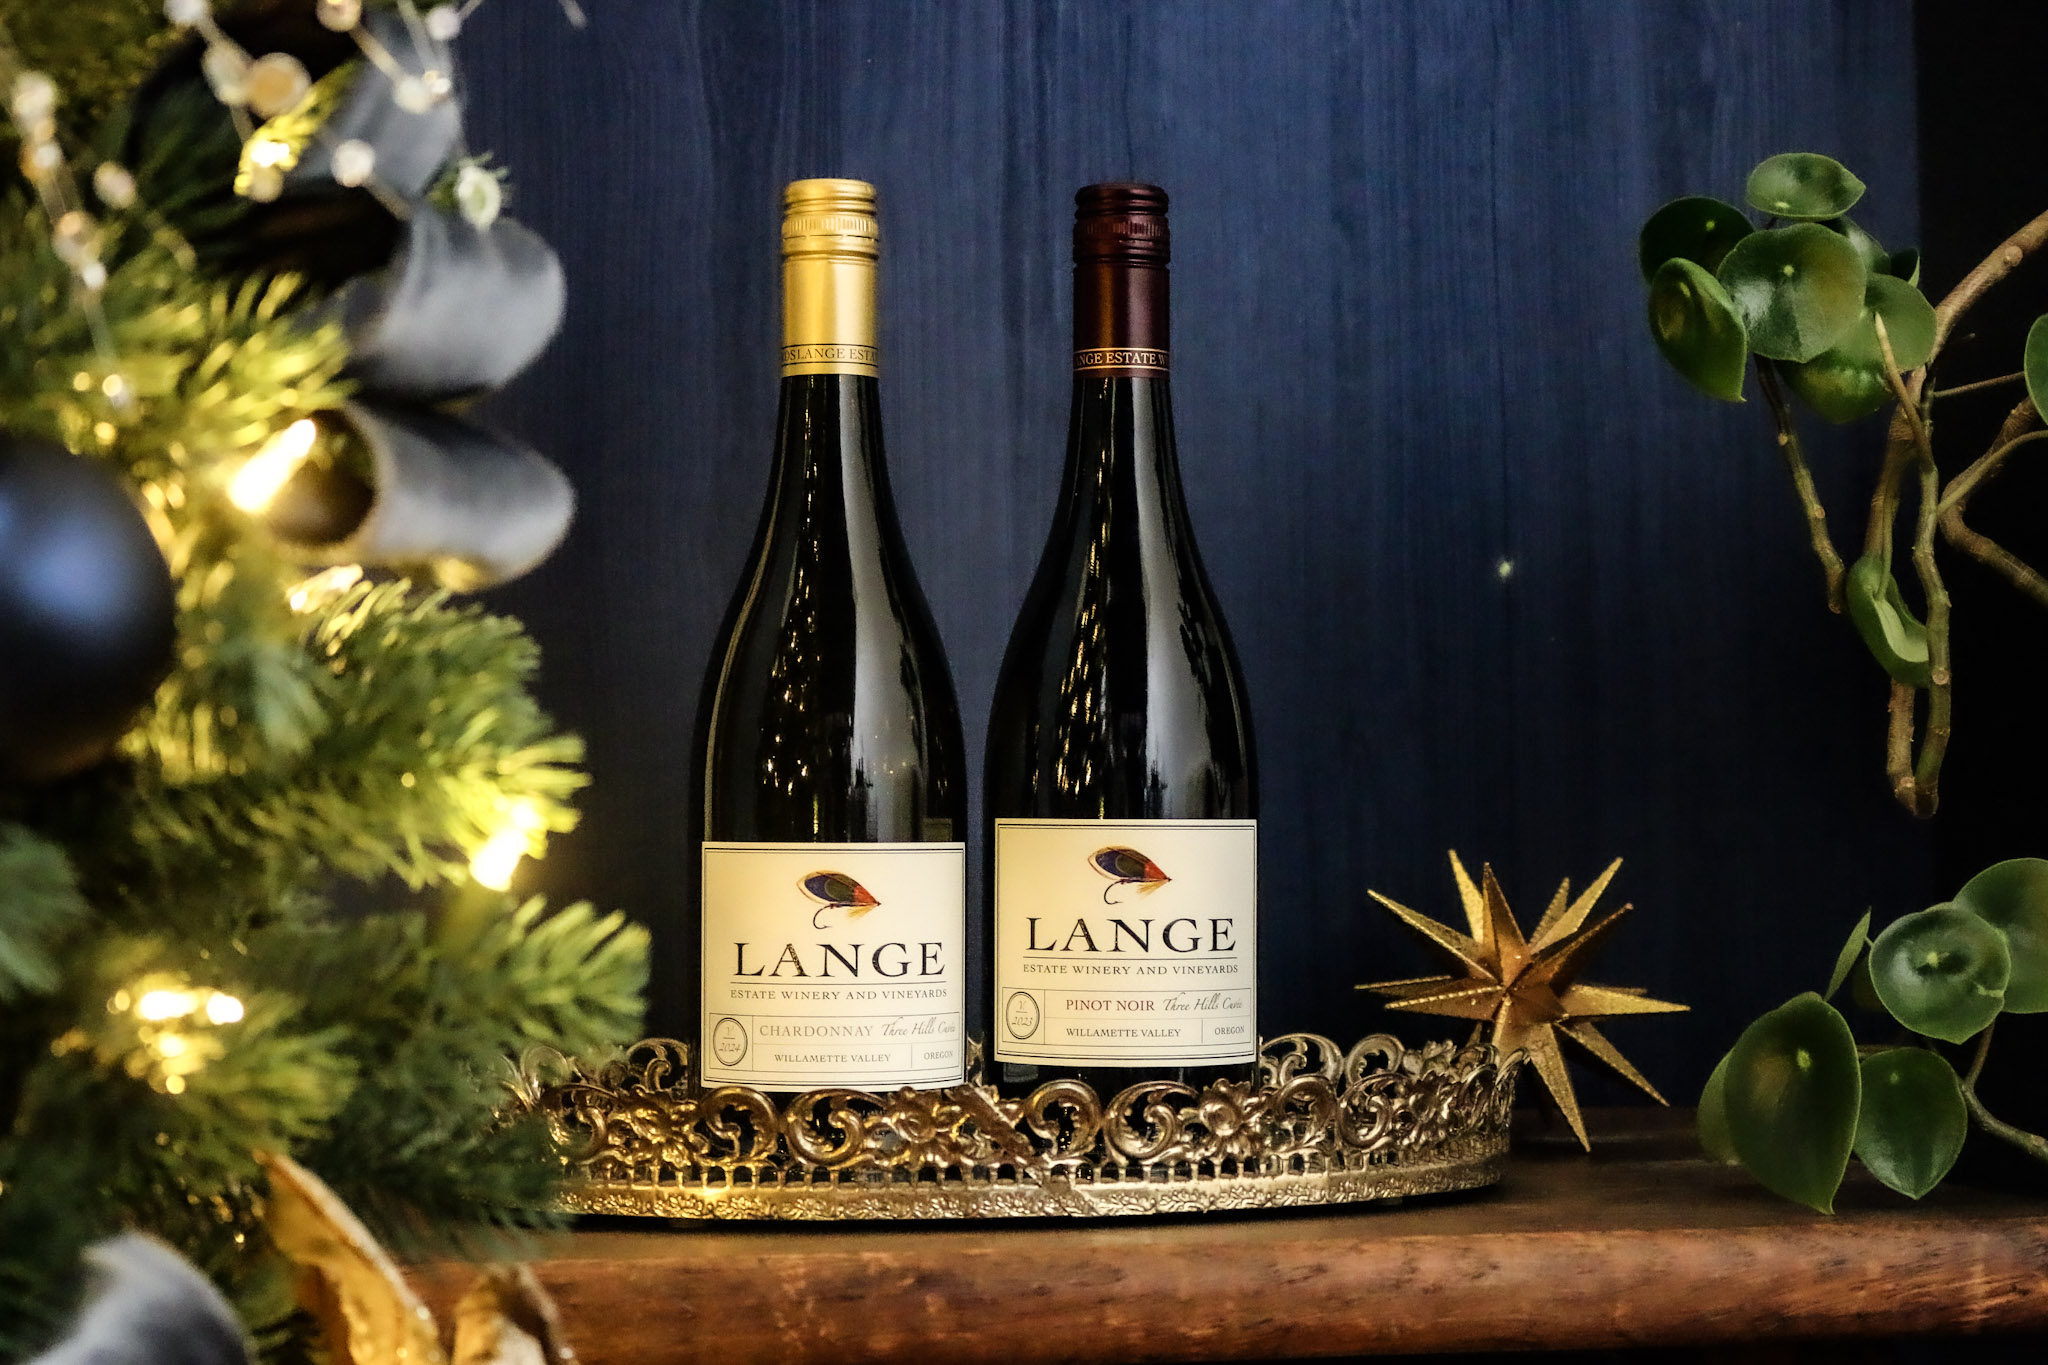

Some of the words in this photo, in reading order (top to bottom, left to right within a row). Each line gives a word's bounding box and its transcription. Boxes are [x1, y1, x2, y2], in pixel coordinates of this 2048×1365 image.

[1106, 352, 1157, 365] ESTATE
[1025, 917, 1237, 953] LANGE
[732, 942, 946, 978] LANGE
[1023, 964, 1068, 974] ESTATE
[1073, 965, 1131, 975] WINERY
[1136, 965, 1168, 975] AND
[1173, 964, 1239, 975] VINEYARDS
[730, 989, 776, 1000] ESTATE
[781, 990, 841, 1001] WINERY
[846, 990, 877, 1000] AND
[882, 988, 948, 1000] VINEYARDS
[1066, 999, 1112, 1012] PINOT
[1115, 999, 1155, 1011] NOIR
[1162, 991, 1191, 1012] Three
[1194, 992, 1221, 1011] Hills
[759, 1024, 873, 1037] CHARDONNAY
[881, 1016, 908, 1036] Three
[911, 1016, 937, 1035] Hills
[1214, 1025, 1245, 1036] OREGON
[1066, 1028, 1139, 1038] WILLAMETTE
[1141, 1028, 1182, 1038] VALLEY
[718, 1042, 742, 1053] 2024
[774, 1053, 848, 1063] WILLAMETTE
[850, 1053, 892, 1063] VALLEY
[923, 1050, 954, 1061] OREGON
